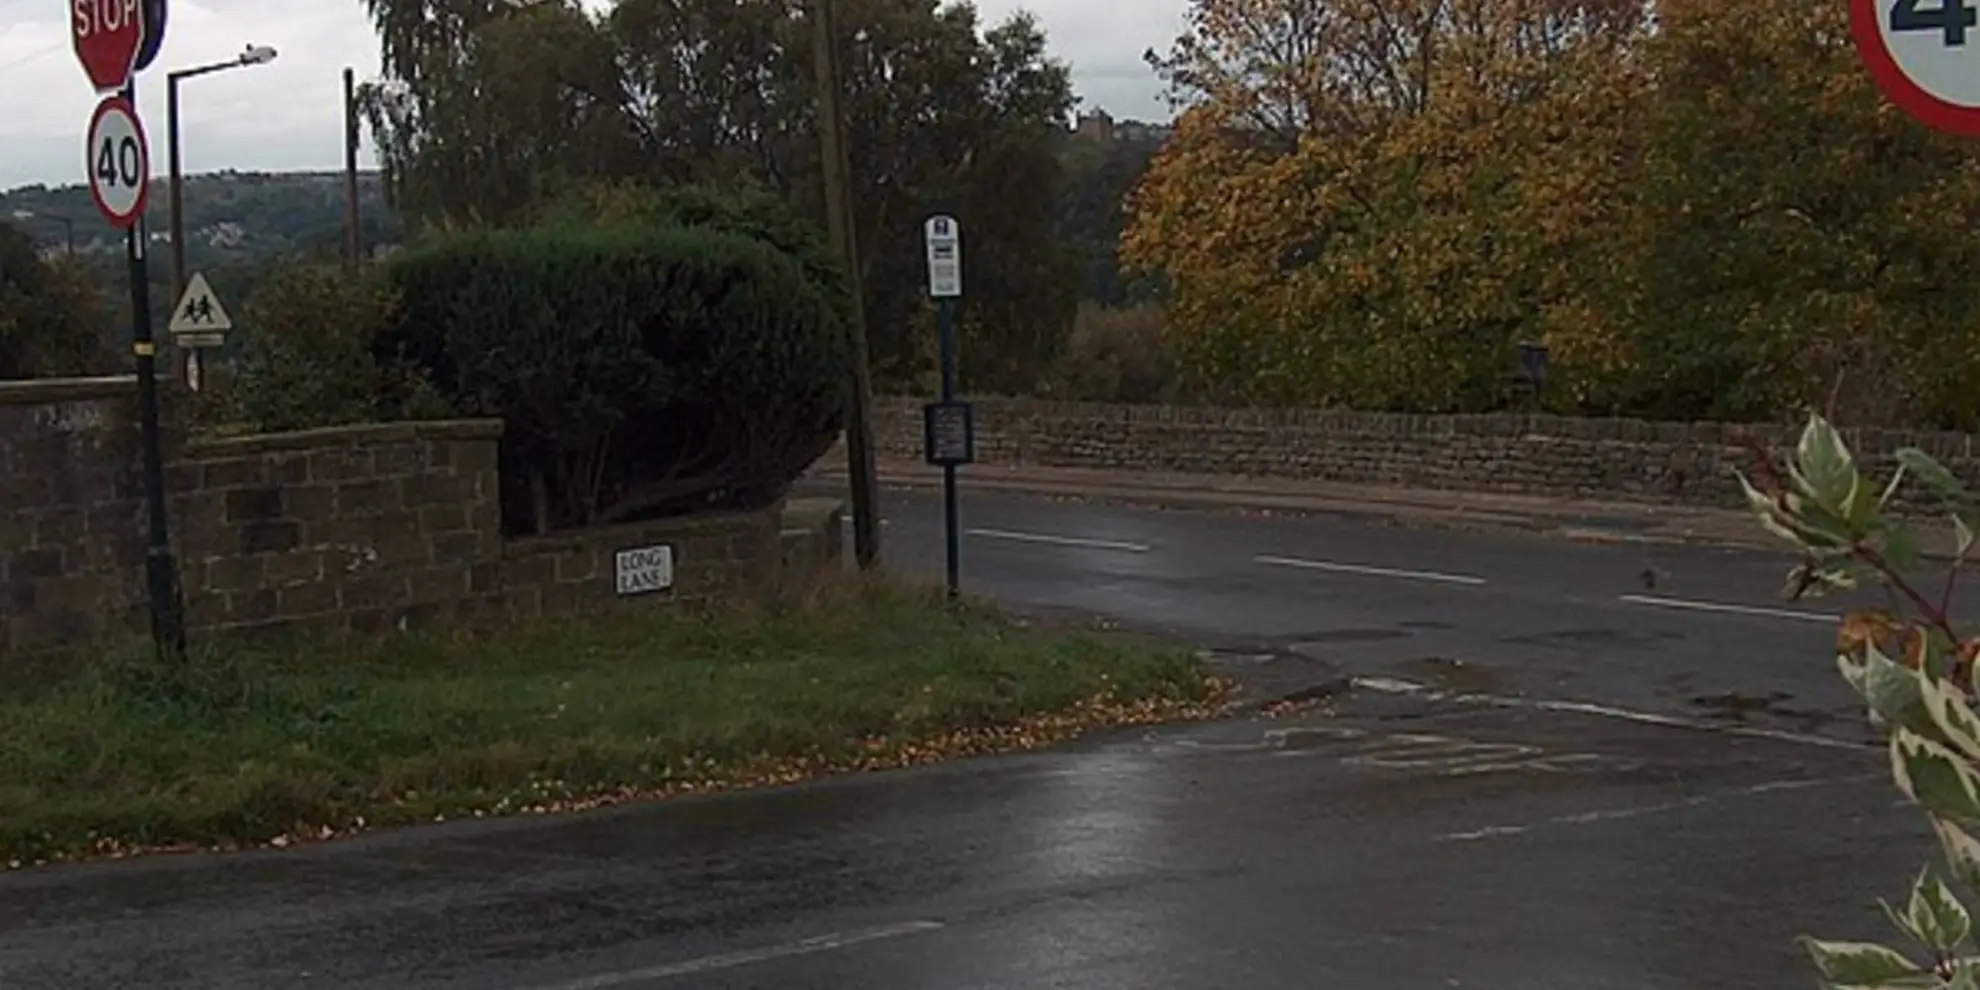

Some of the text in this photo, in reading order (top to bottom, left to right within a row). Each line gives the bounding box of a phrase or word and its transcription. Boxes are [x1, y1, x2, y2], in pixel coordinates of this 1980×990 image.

[74, 0, 136, 37] STOP
[97, 135, 139, 188] 40
[620, 549, 661, 571] LONG
